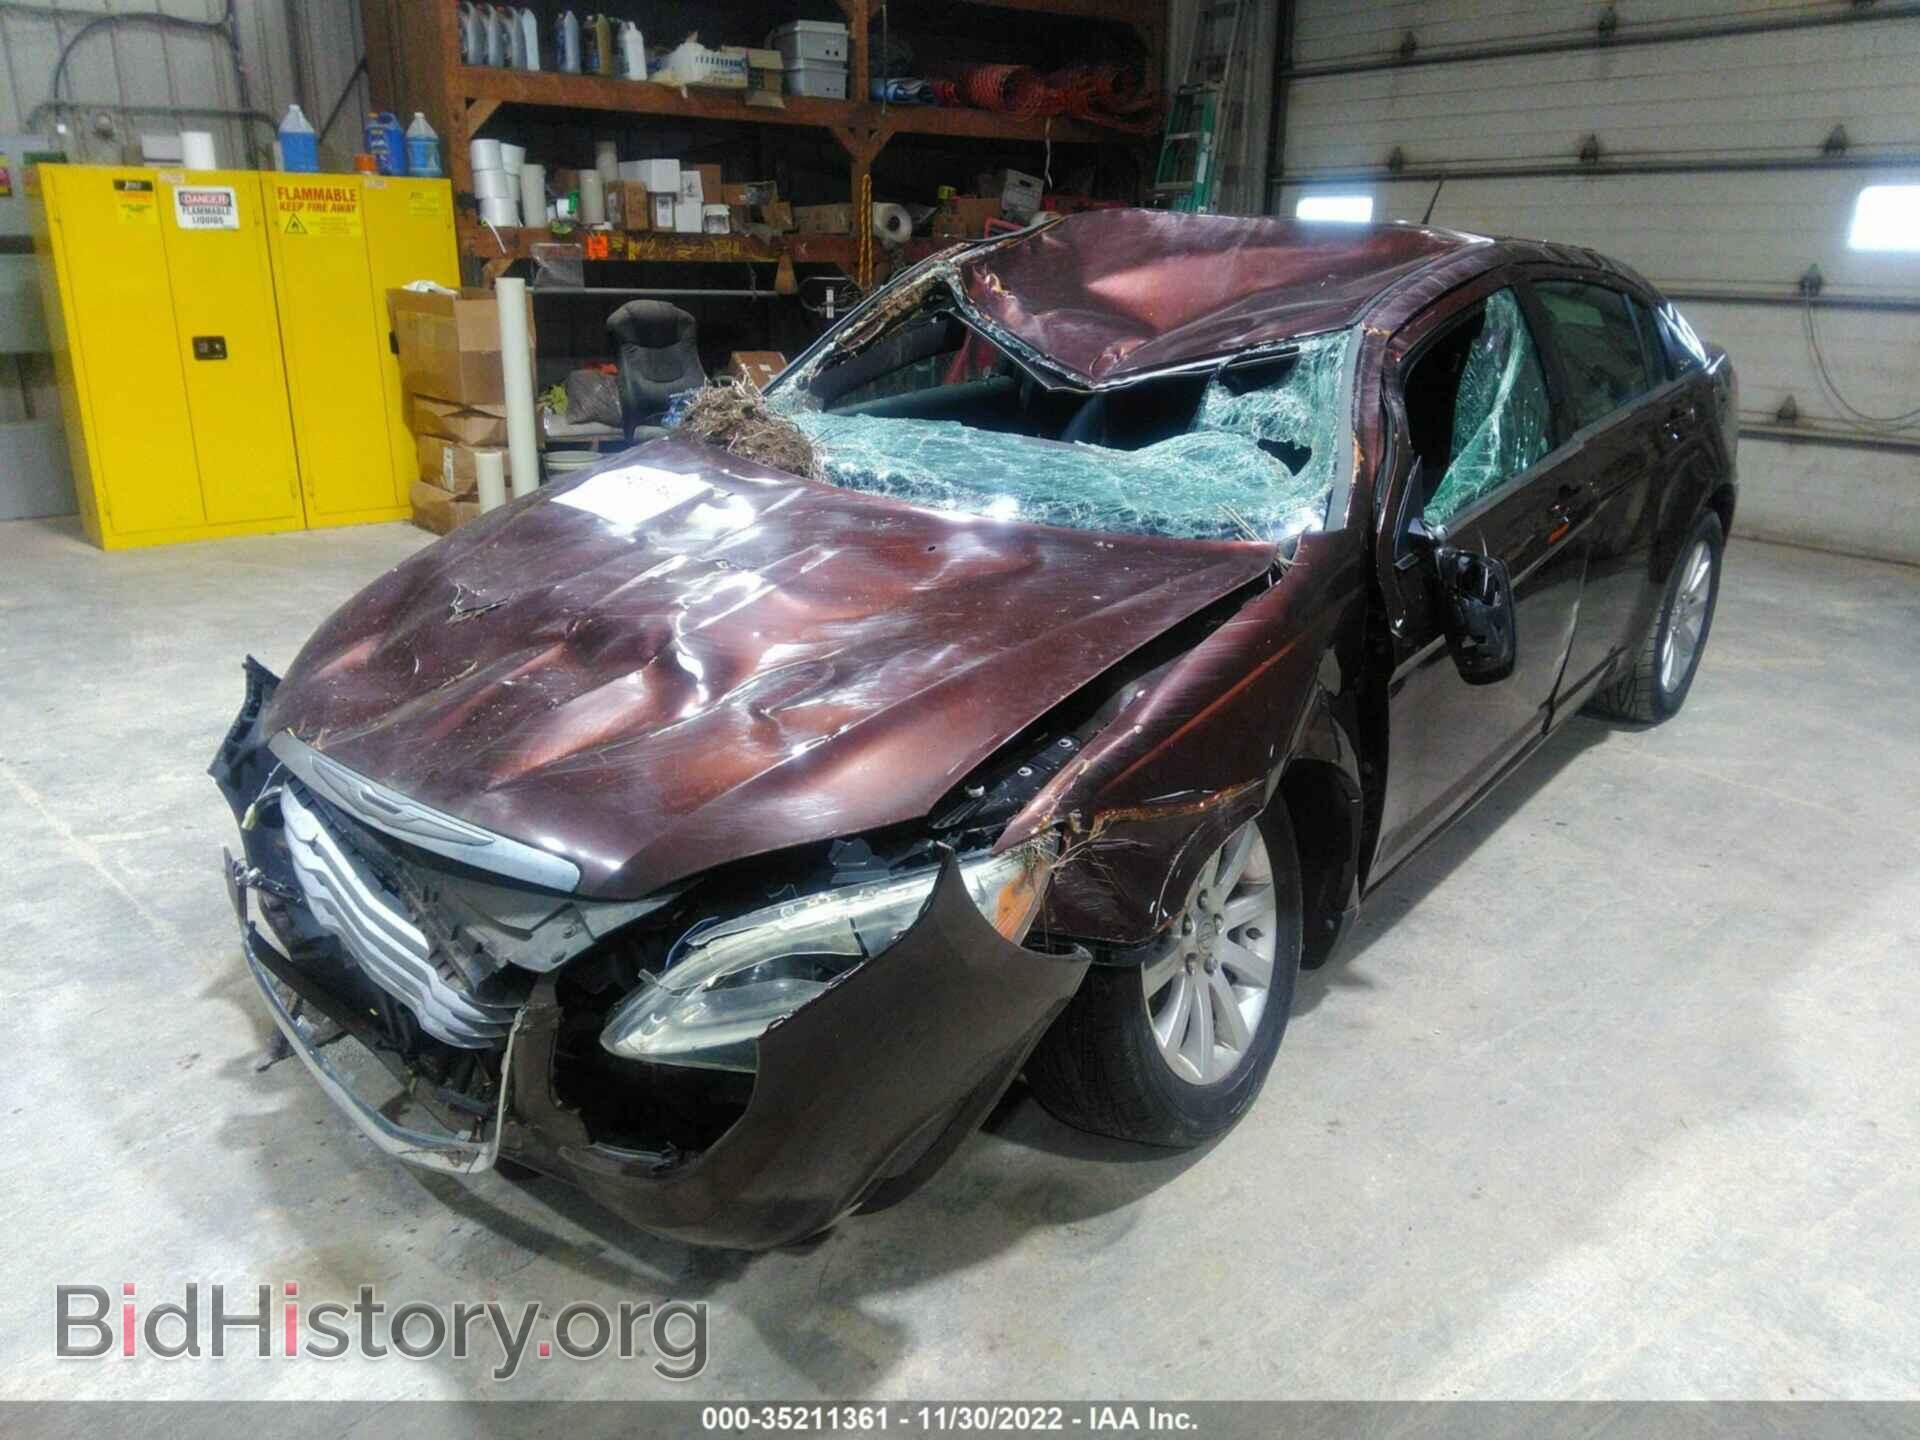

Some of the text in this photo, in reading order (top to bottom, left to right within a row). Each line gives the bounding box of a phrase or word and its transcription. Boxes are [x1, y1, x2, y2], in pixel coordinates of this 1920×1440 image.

[277, 186, 356, 201] FLAMMABLE
[182, 193, 227, 206] DANGER
[182, 207, 231, 216] FLAMMABLE
[279, 203, 356, 213] KEEP FIRE AWAY
[192, 216, 224, 224] LIQUIDS
